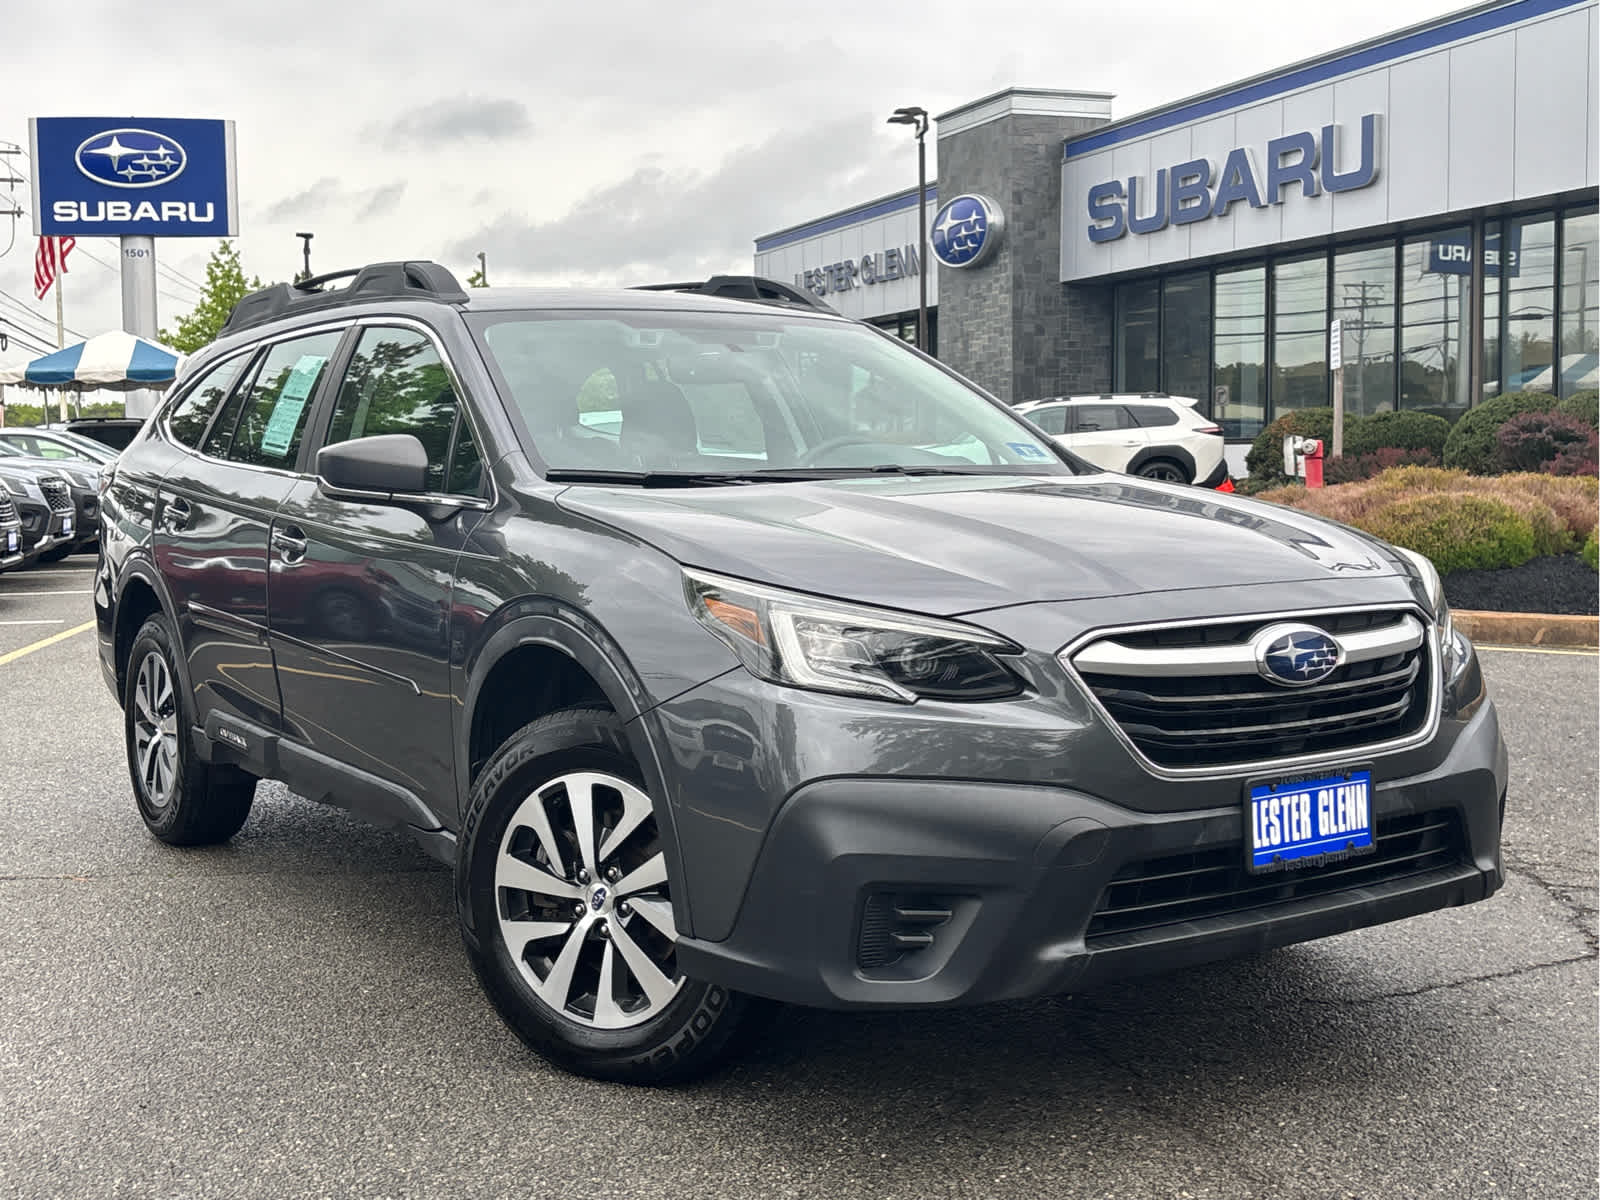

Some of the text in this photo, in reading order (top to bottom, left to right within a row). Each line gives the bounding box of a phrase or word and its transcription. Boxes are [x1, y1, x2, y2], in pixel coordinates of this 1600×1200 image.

[1087, 113, 1384, 242] SUBARU
[53, 201, 215, 222] SUBARU
[124, 248, 150, 258] 1501
[1252, 783, 1368, 849] LESTER GLENN
